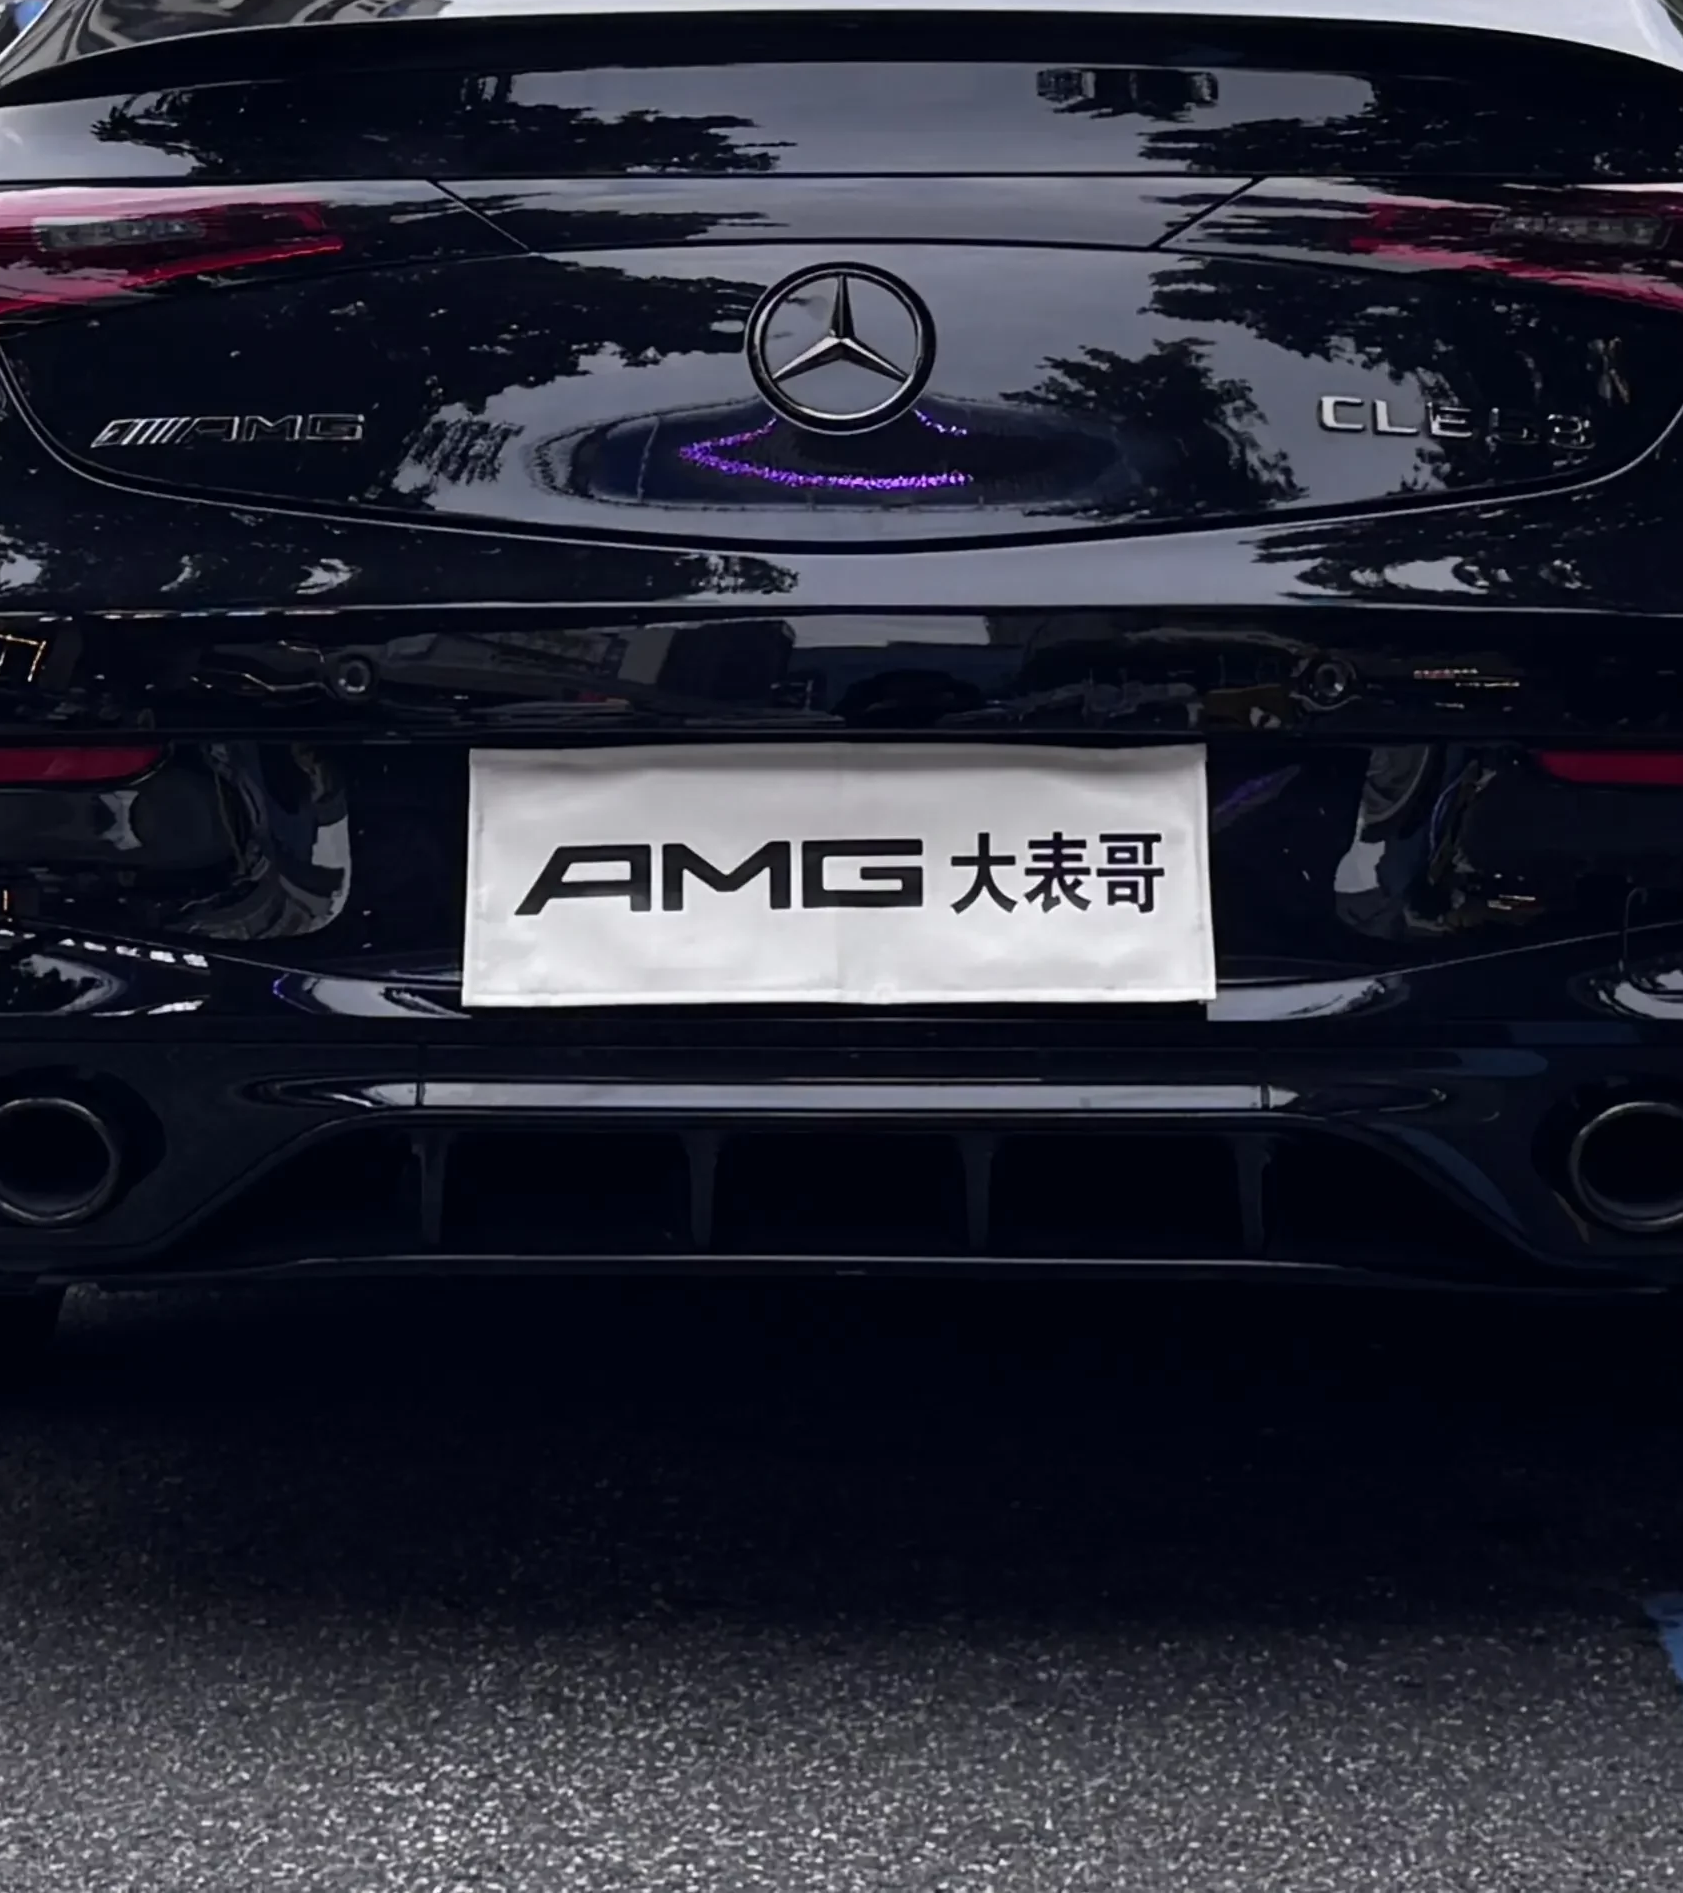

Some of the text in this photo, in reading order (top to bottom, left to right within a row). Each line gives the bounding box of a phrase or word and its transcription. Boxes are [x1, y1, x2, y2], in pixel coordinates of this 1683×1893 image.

[514, 831, 1165, 916] AMG 大表哥
